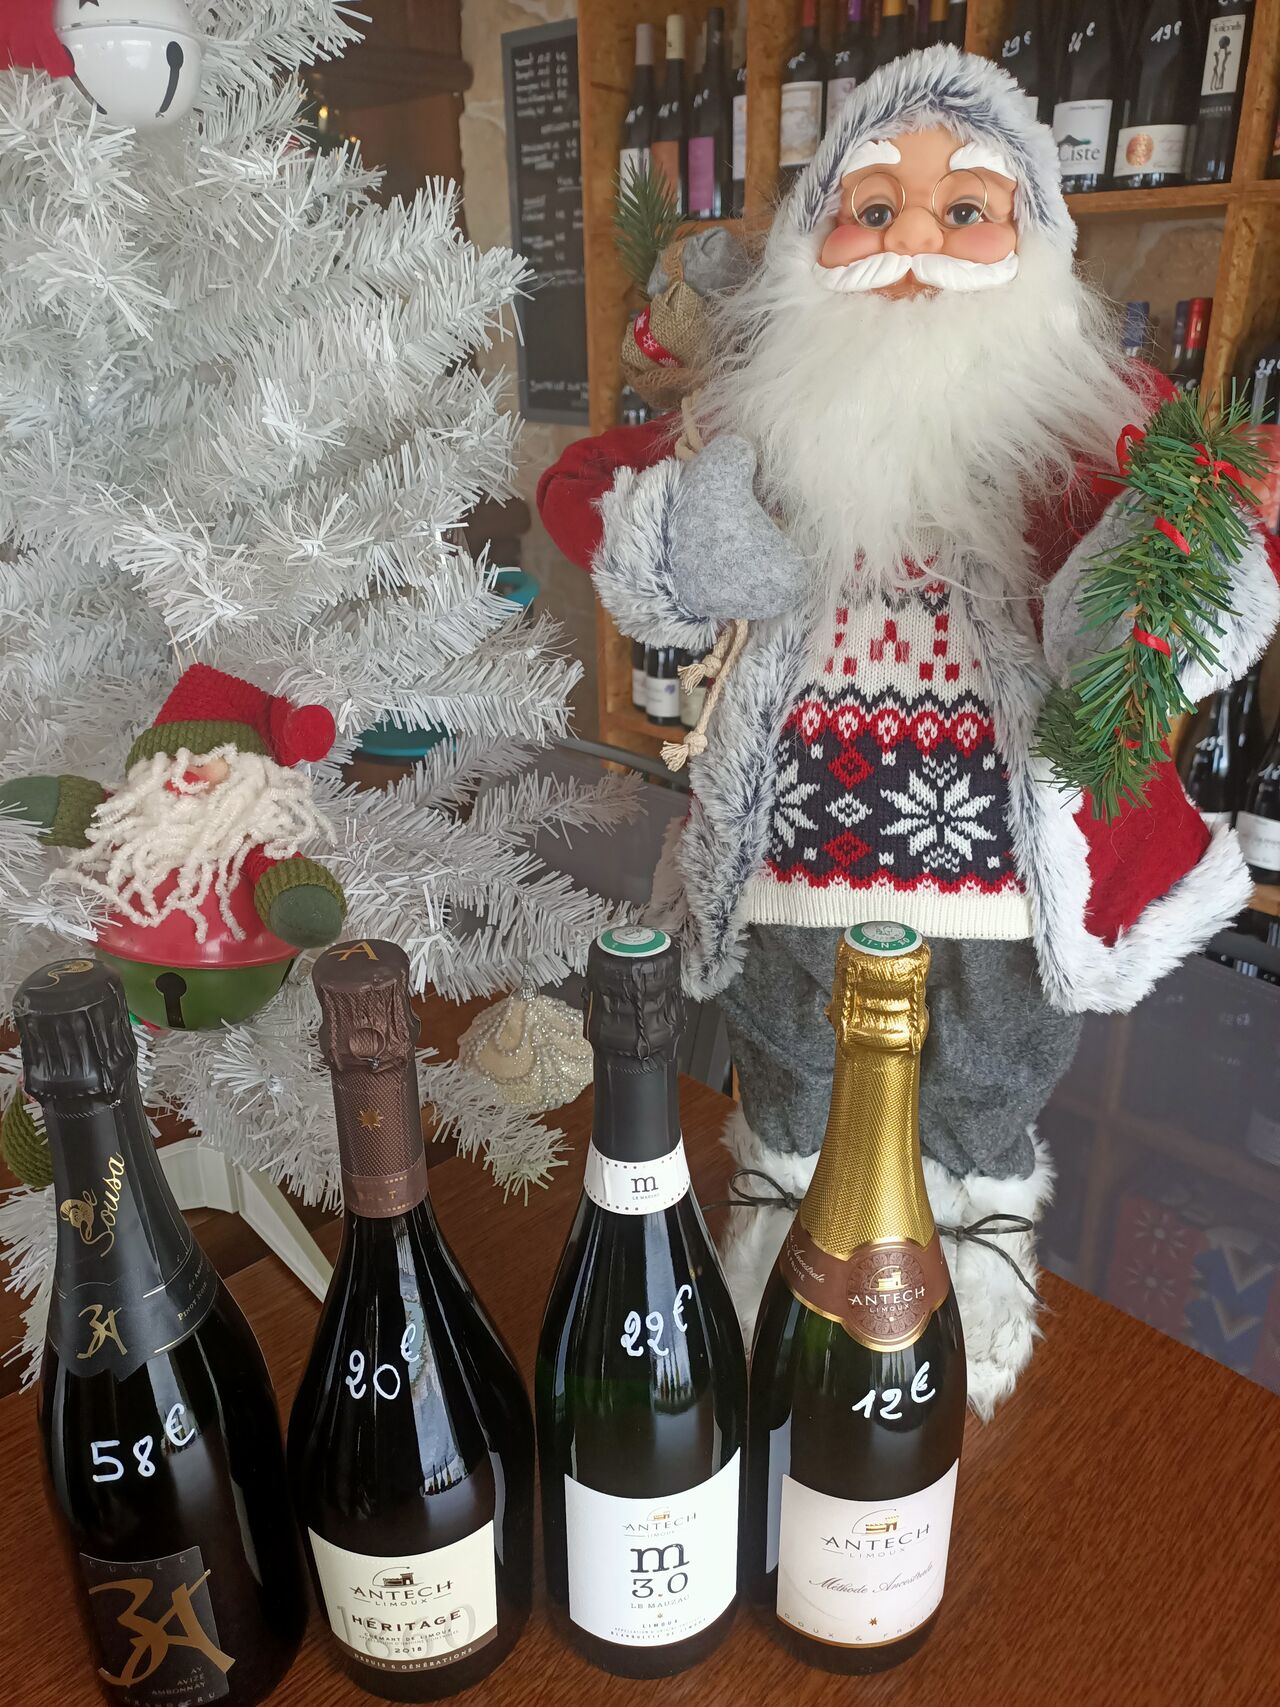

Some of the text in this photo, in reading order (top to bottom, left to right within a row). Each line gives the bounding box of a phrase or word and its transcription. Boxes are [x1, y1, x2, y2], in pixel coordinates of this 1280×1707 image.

[1058, 144, 1100, 162] Ciste
[630, 1175, 659, 1193] m
[81, 1151, 126, 1257] Sousa
[848, 1286, 926, 1306] ANTECH
[869, 1303, 909, 1313] LIMOUX
[622, 1512, 698, 1531] ANTECH
[820, 1523, 930, 1551] ANTECH
[630, 1542, 690, 1573] m
[849, 1548, 905, 1559] LIMOUX
[350, 1580, 454, 1601] ANTECH
[631, 1572, 689, 1599] 3.0
[809, 1577, 868, 1594] Méthode
[374, 1598, 429, 1608] LIMOUX
[351, 1609, 462, 1632] HÉRITAGE
[394, 1646, 423, 1654] 2018
[401, 1646, 474, 1671] GÉNÉRATIONS
